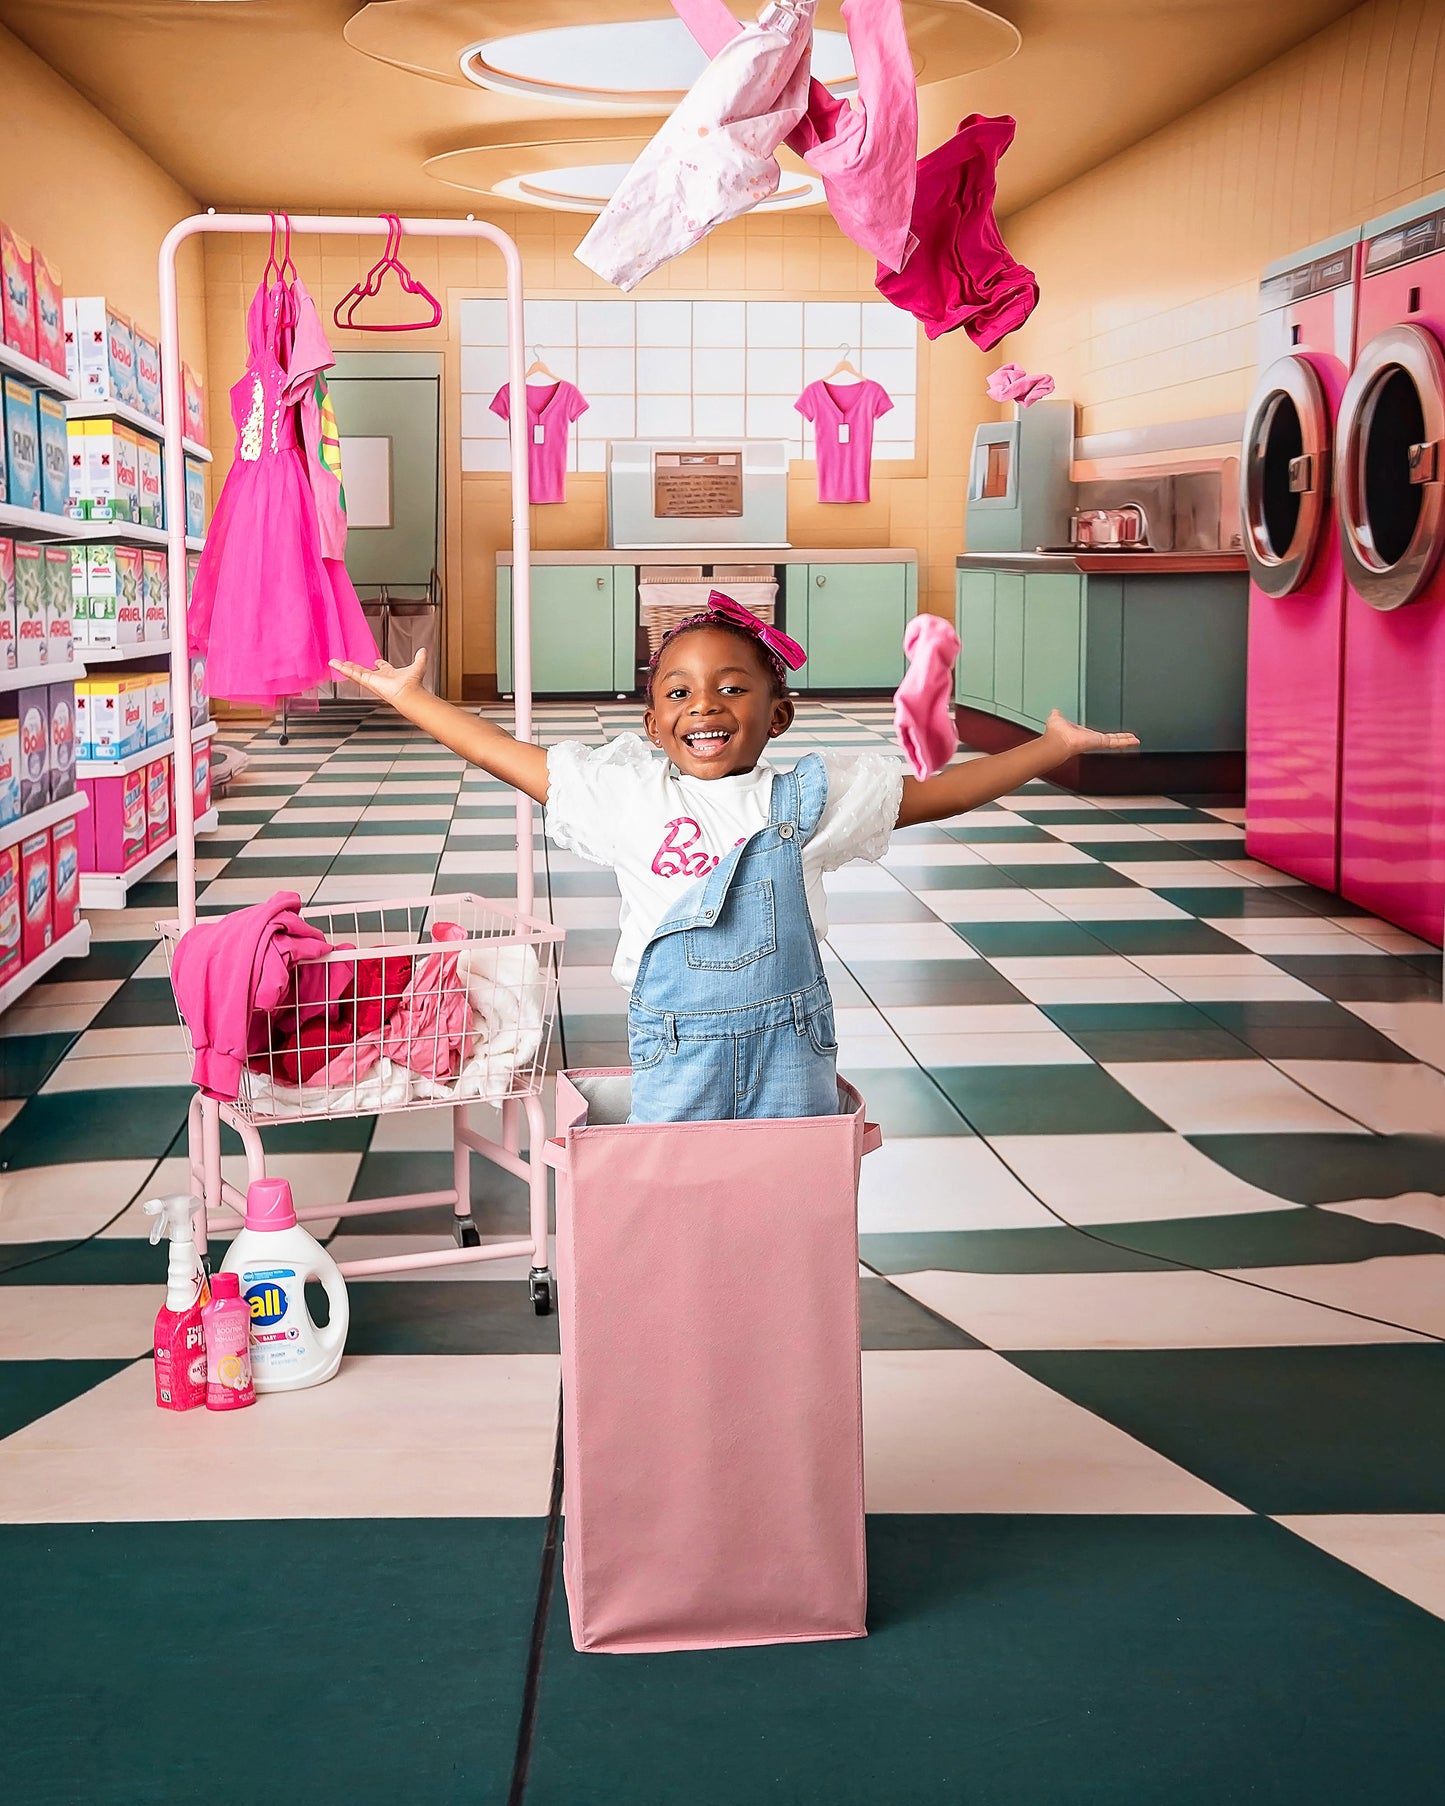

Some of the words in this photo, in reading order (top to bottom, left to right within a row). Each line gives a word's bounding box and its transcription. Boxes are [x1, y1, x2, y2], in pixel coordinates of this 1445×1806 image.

[111, 336, 132, 368] Bold
[140, 357, 157, 385] Bold
[117, 460, 136, 487] Persil
[118, 607, 141, 622] ARIEL
[146, 607, 166, 621] ARIEL
[20, 620, 45, 640] ARIEL
[50, 620, 72, 638] ARIEL
[248, 1289, 281, 1318] all
[187, 1332, 206, 1350] PI
[262, 1334, 277, 1342] BABY
